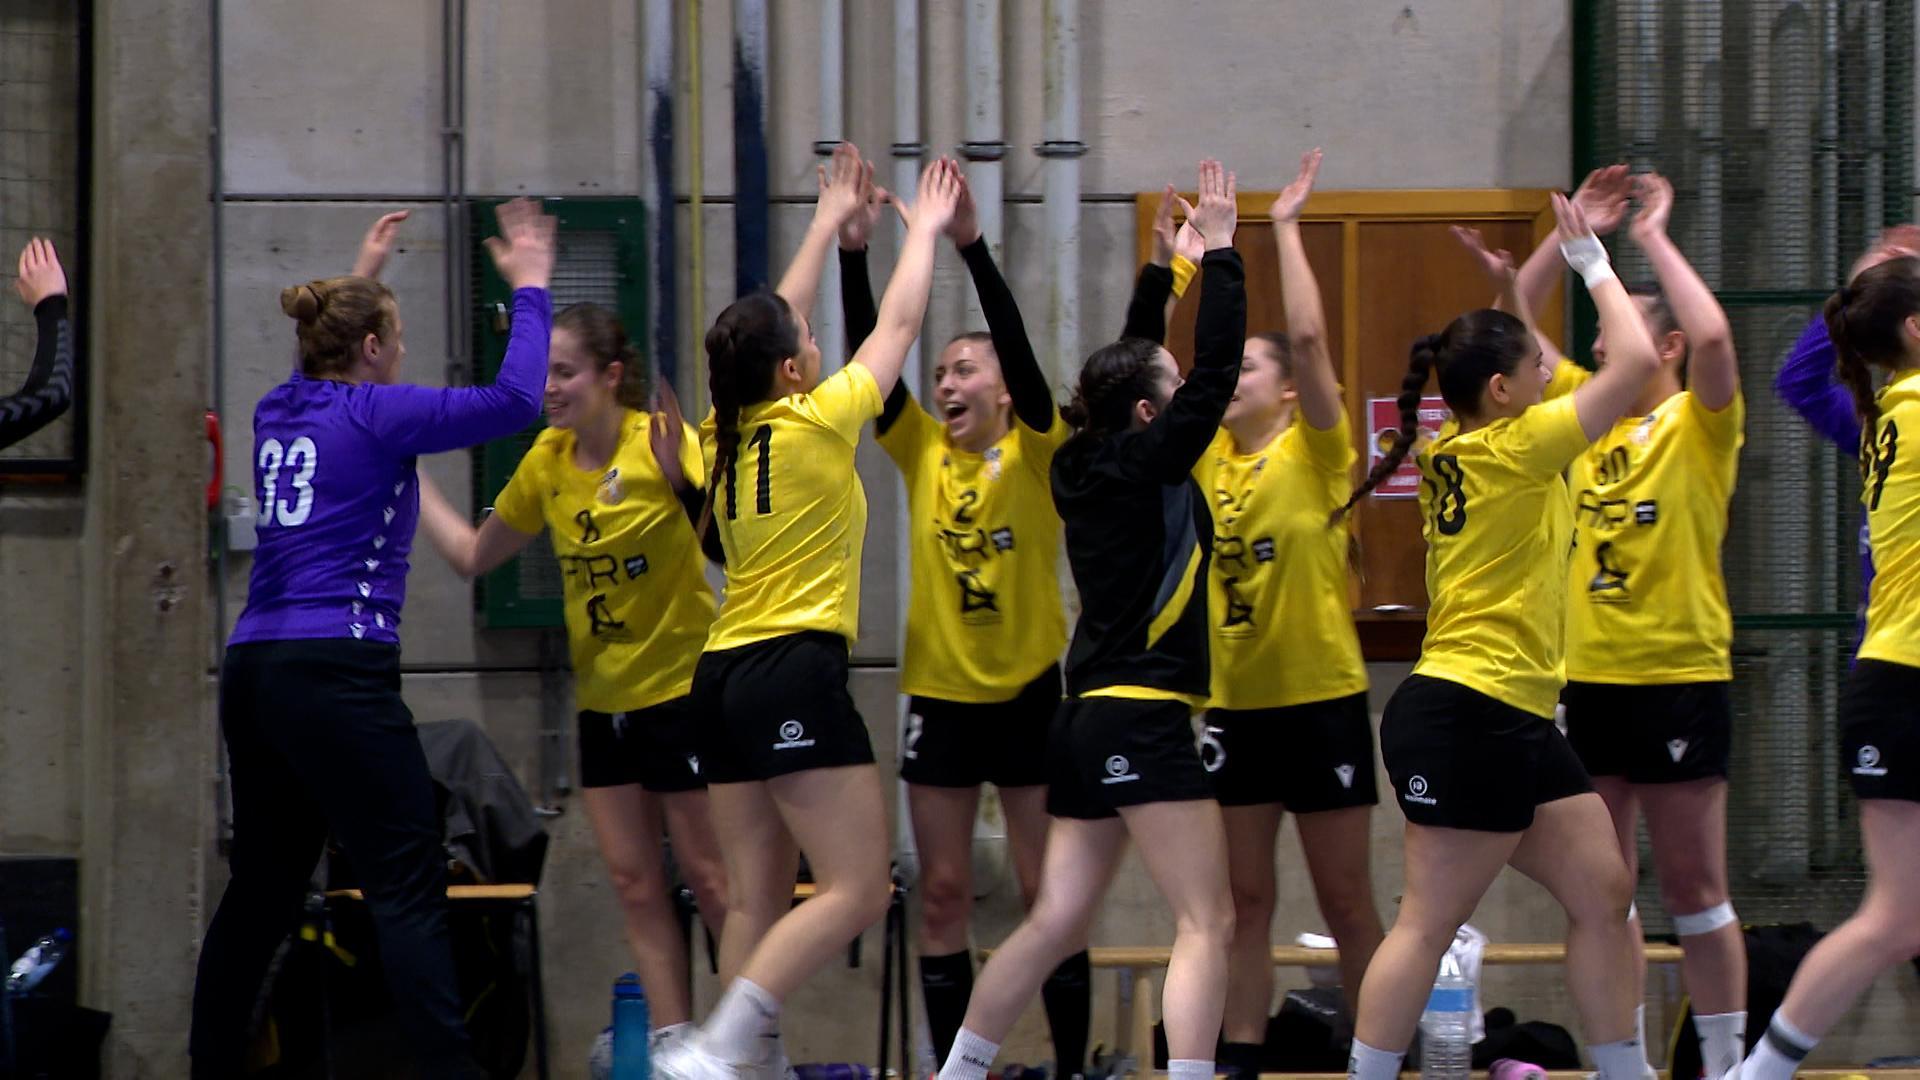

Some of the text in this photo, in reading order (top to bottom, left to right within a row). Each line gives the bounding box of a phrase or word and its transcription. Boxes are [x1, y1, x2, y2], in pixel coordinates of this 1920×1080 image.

[257, 436, 317, 527] 33
[722, 423, 772, 519] 11
[576, 509, 600, 543] 8
[954, 489, 986, 524] 2
